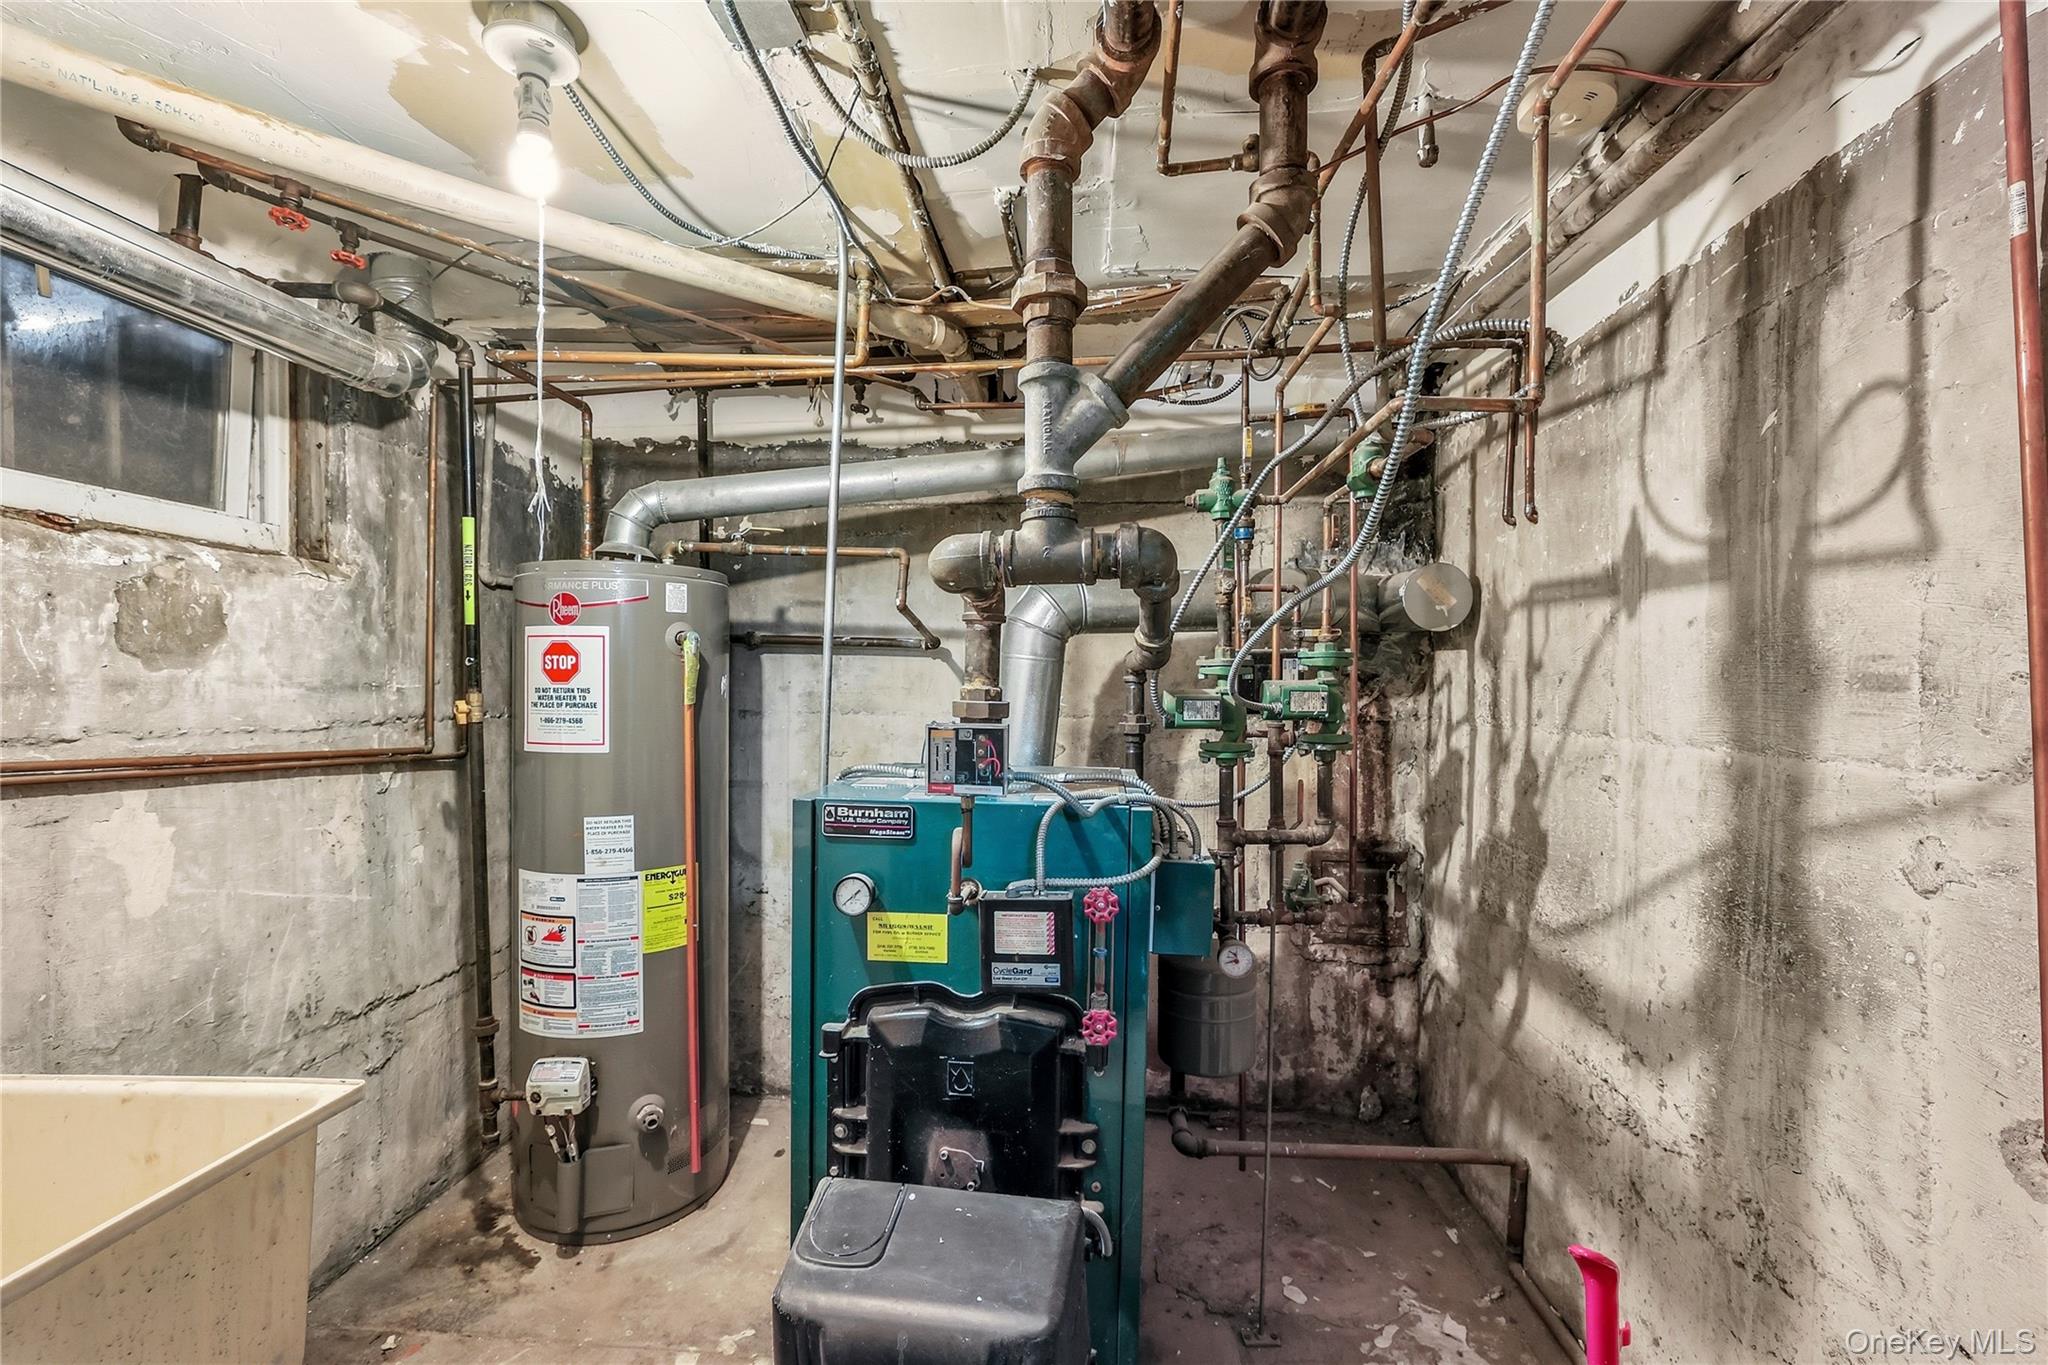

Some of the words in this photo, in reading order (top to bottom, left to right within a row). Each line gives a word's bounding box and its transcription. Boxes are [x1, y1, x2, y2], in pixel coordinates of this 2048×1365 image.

[463, 573, 473, 587] GAS
[591, 580, 619, 590] PLUS
[551, 593, 580, 621] Rheem
[544, 655, 576, 670] STOP
[837, 807, 909, 818] Burnham
[993, 966, 1033, 975] CycleGard
